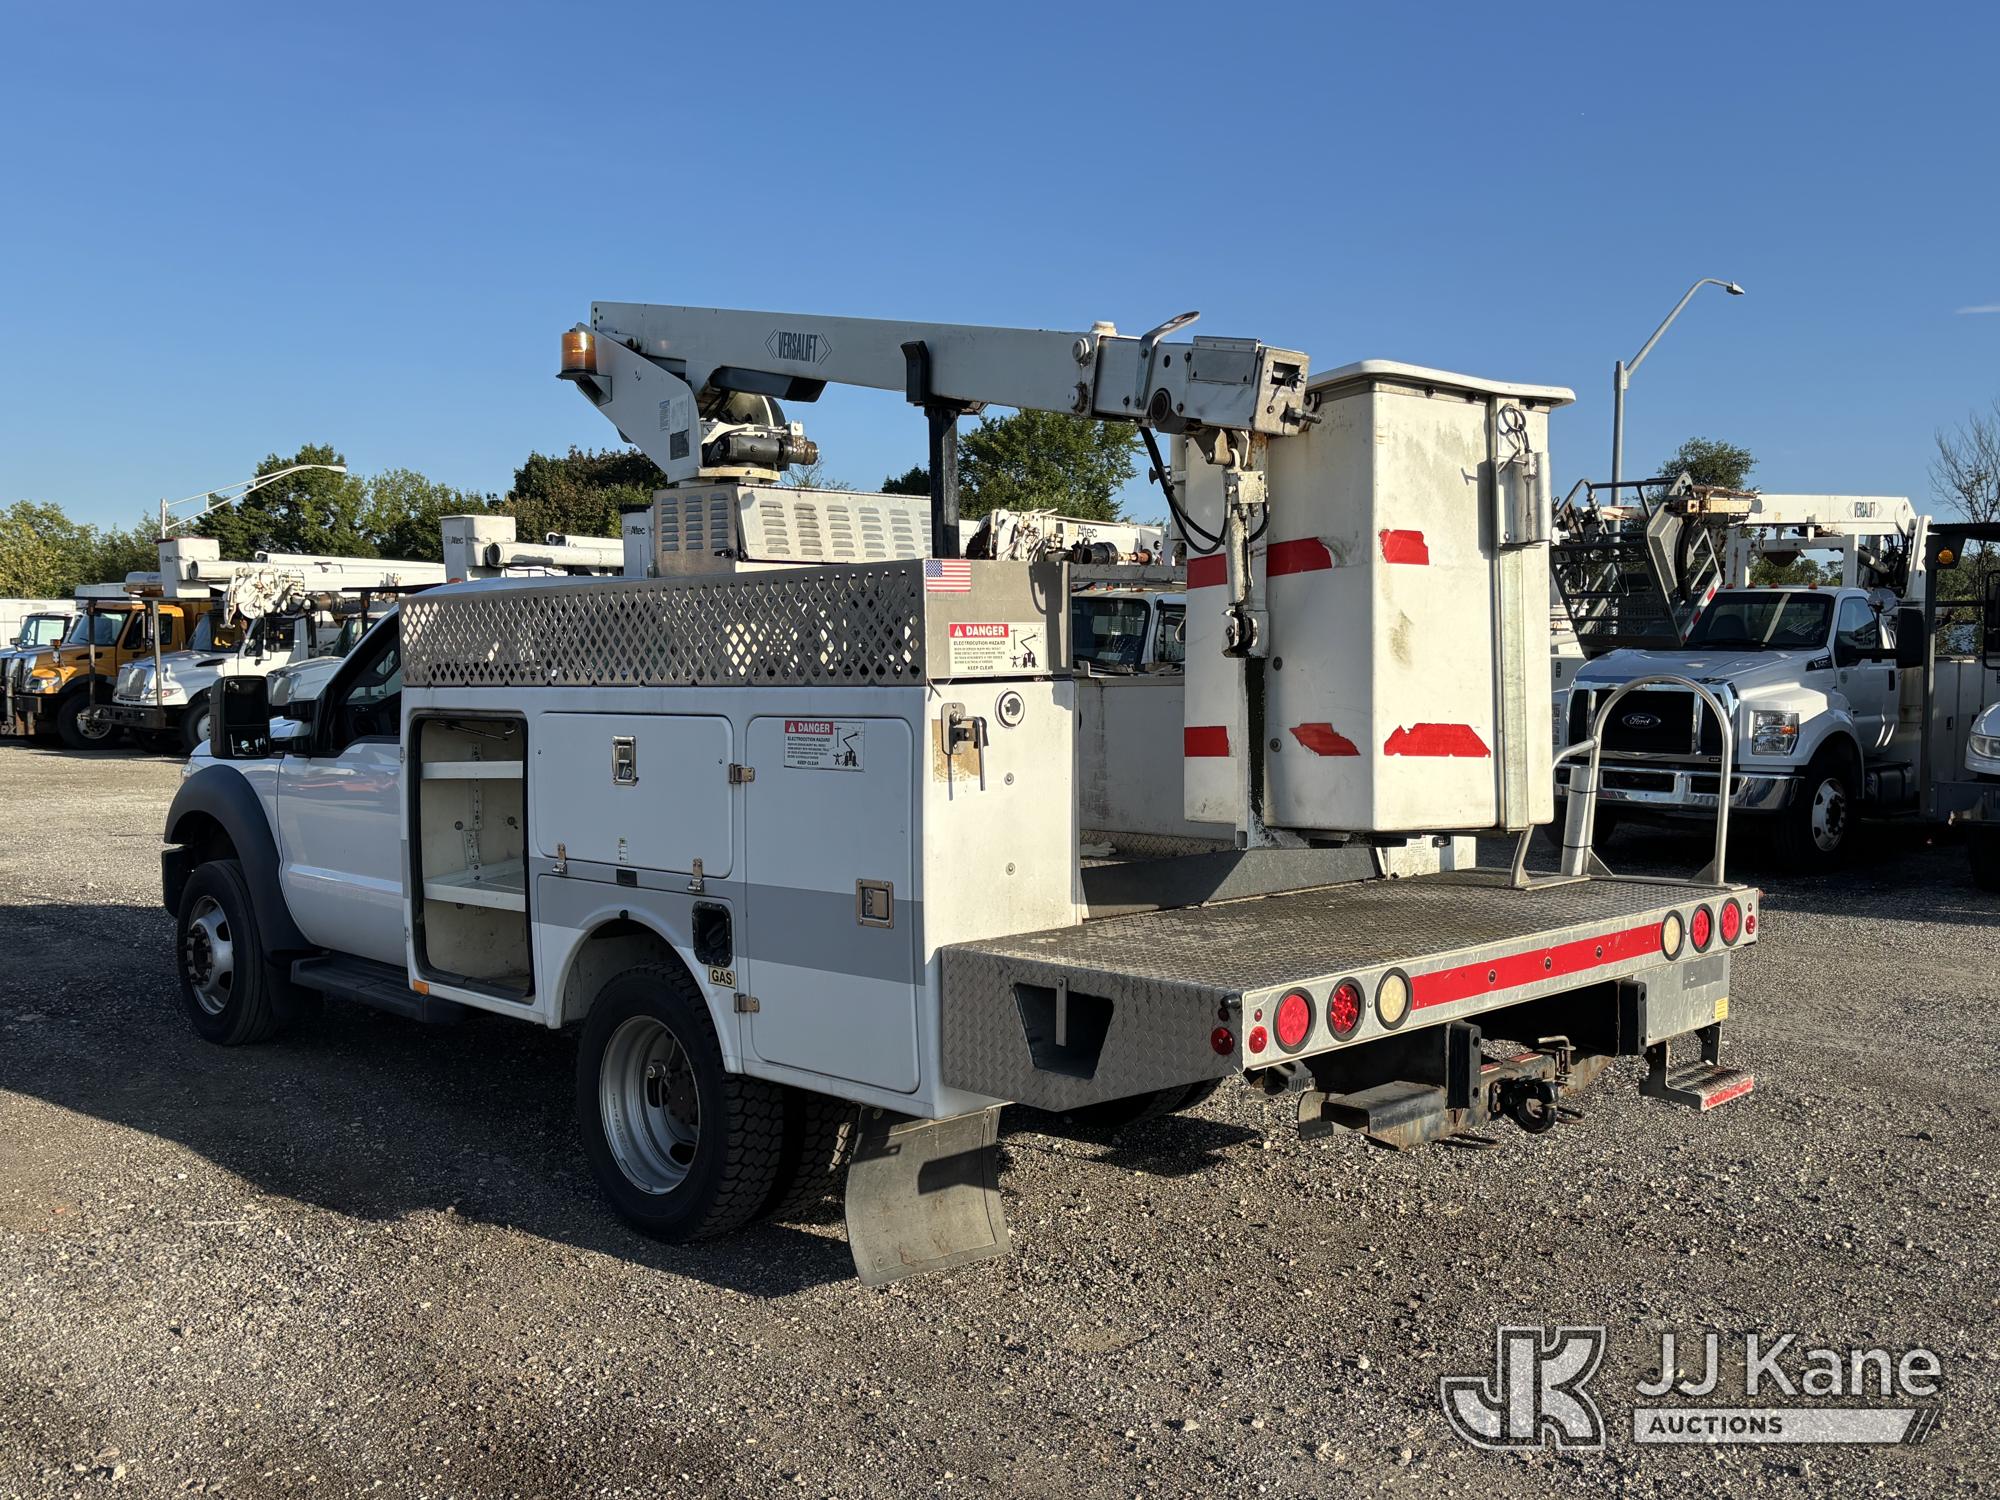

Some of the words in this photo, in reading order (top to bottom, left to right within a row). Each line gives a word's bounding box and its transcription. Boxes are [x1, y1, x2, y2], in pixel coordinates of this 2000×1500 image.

[778, 331, 818, 363] VERSALIFT
[1854, 501, 1876, 518] VERSALIFT
[630, 525, 646, 535] Altec
[1077, 524, 1098, 538] Altec
[966, 625, 1005, 636] DANGER
[798, 723, 830, 734] DANGER
[711, 969, 733, 986] GAS
